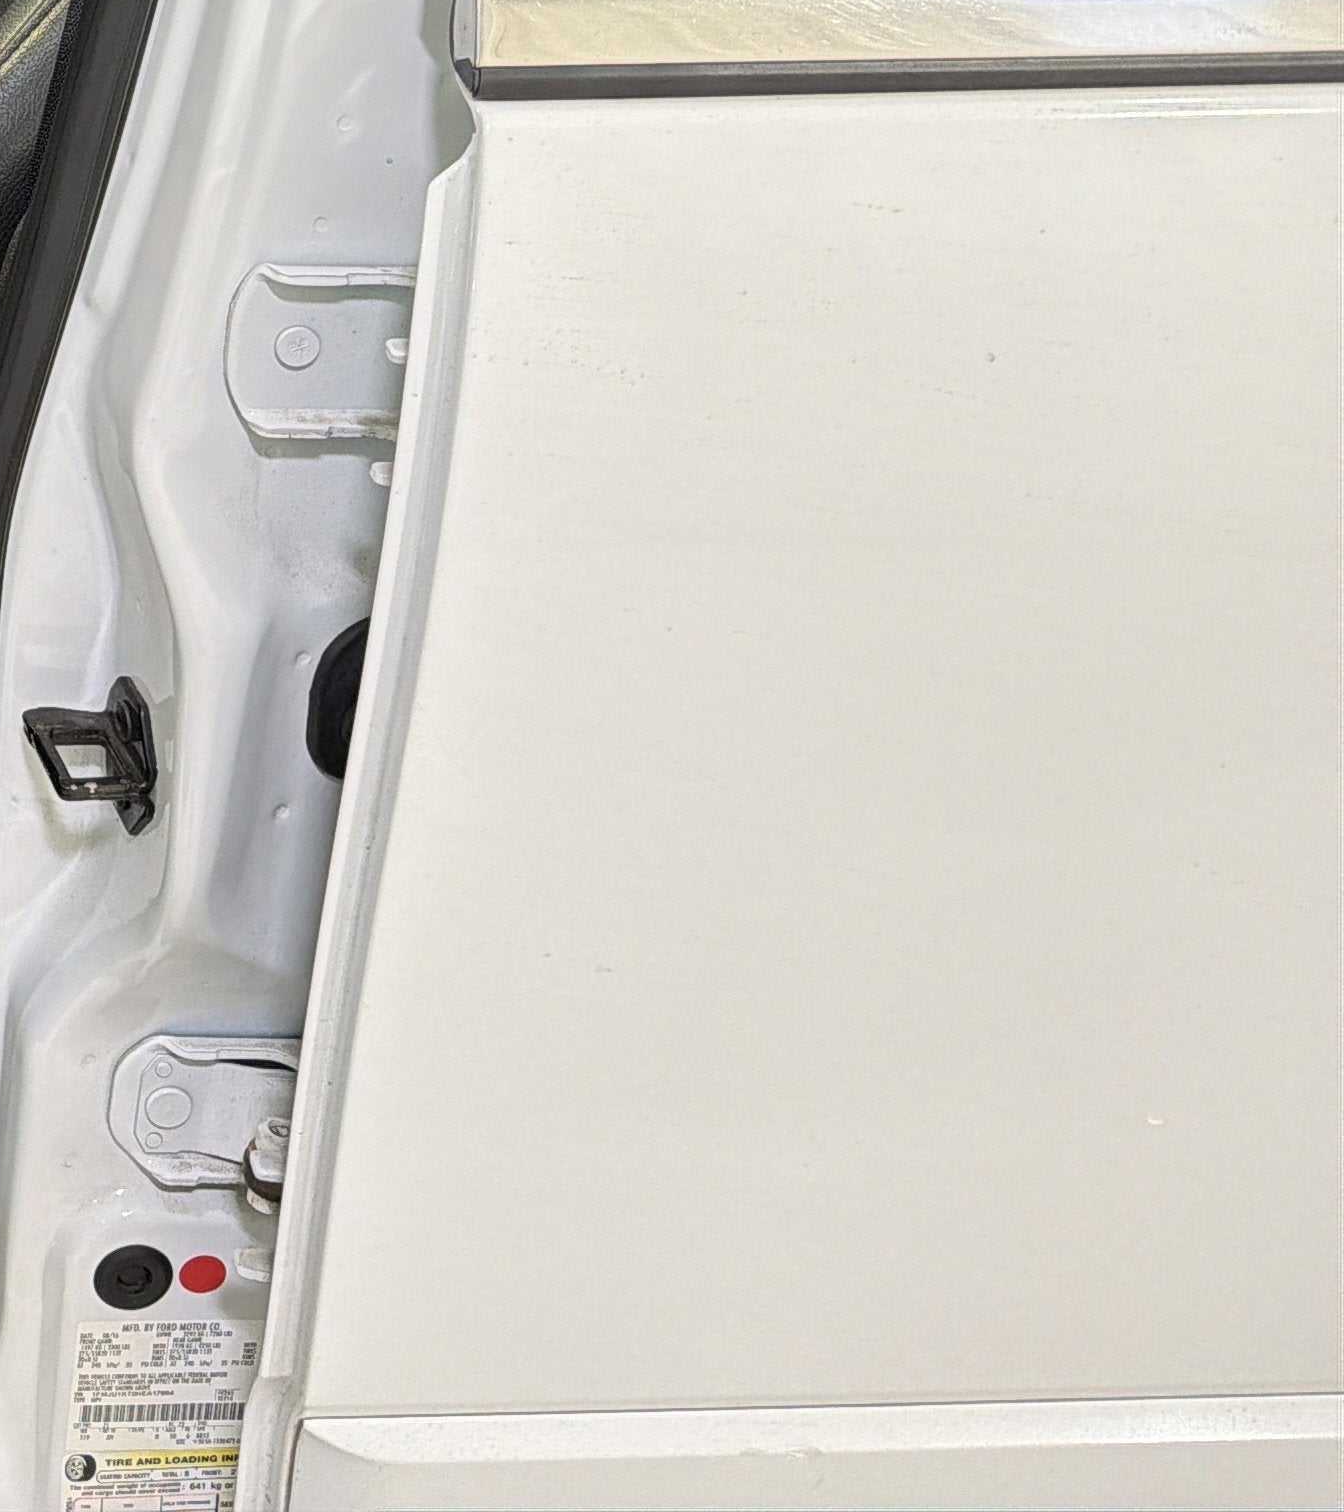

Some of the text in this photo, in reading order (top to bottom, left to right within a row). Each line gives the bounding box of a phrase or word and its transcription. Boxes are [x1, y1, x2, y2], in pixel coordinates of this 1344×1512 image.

[144, 1323, 154, 1332] BY
[156, 1323, 177, 1331] FORD
[179, 1322, 207, 1330] MOTOR
[105, 1458, 133, 1466] TIRE
[136, 1457, 162, 1465] AND
[165, 1455, 218, 1464] LOADING
[211, 1482, 222, 1490] kg
